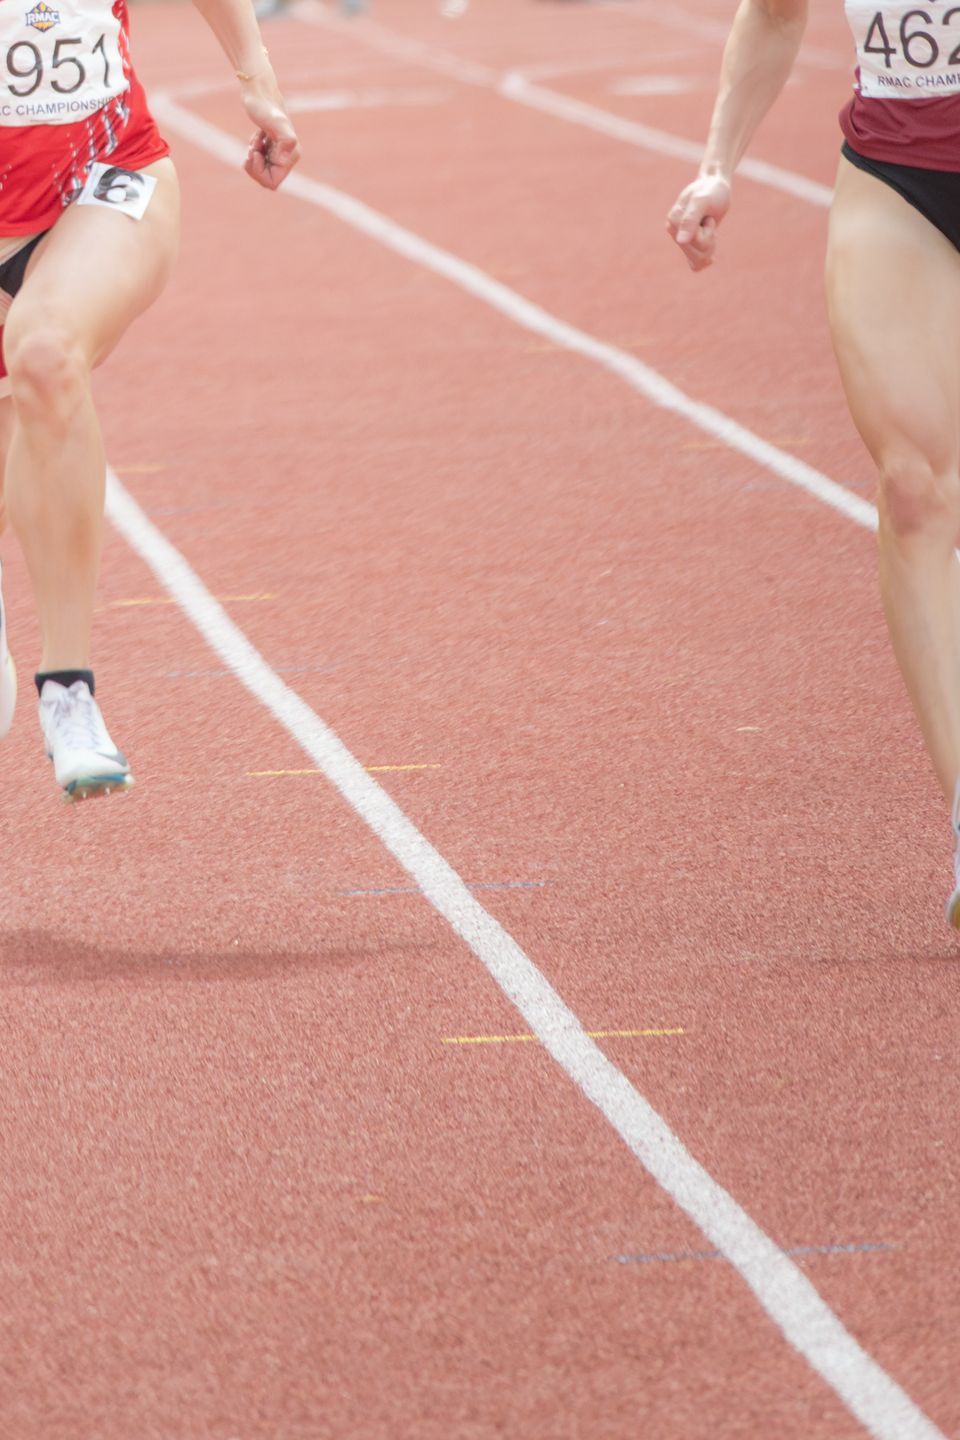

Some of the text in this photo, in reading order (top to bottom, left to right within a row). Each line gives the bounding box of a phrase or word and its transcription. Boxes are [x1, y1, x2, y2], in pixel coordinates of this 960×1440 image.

[25, 10, 61, 26] RMAC
[877, 75, 911, 88] RMAC
[92, 166, 145, 204] 6
